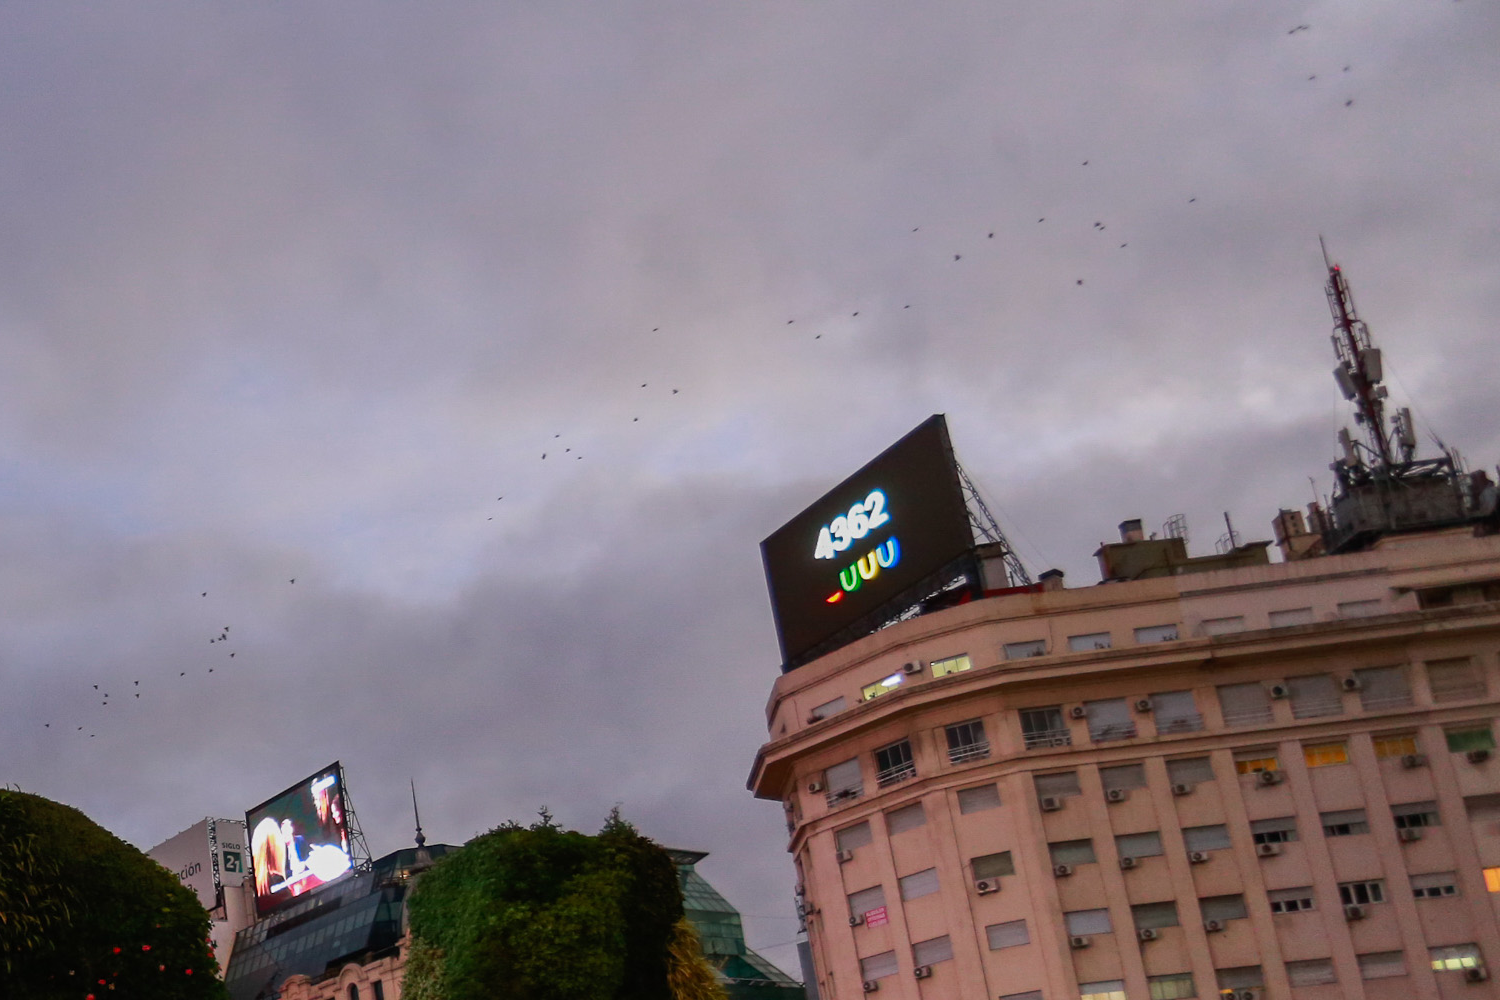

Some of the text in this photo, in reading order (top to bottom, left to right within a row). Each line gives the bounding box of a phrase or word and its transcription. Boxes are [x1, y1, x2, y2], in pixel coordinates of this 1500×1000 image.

[814, 490, 890, 560] 4362
[221, 842, 241, 850] SIGLO
[226, 855, 240, 874] 21
